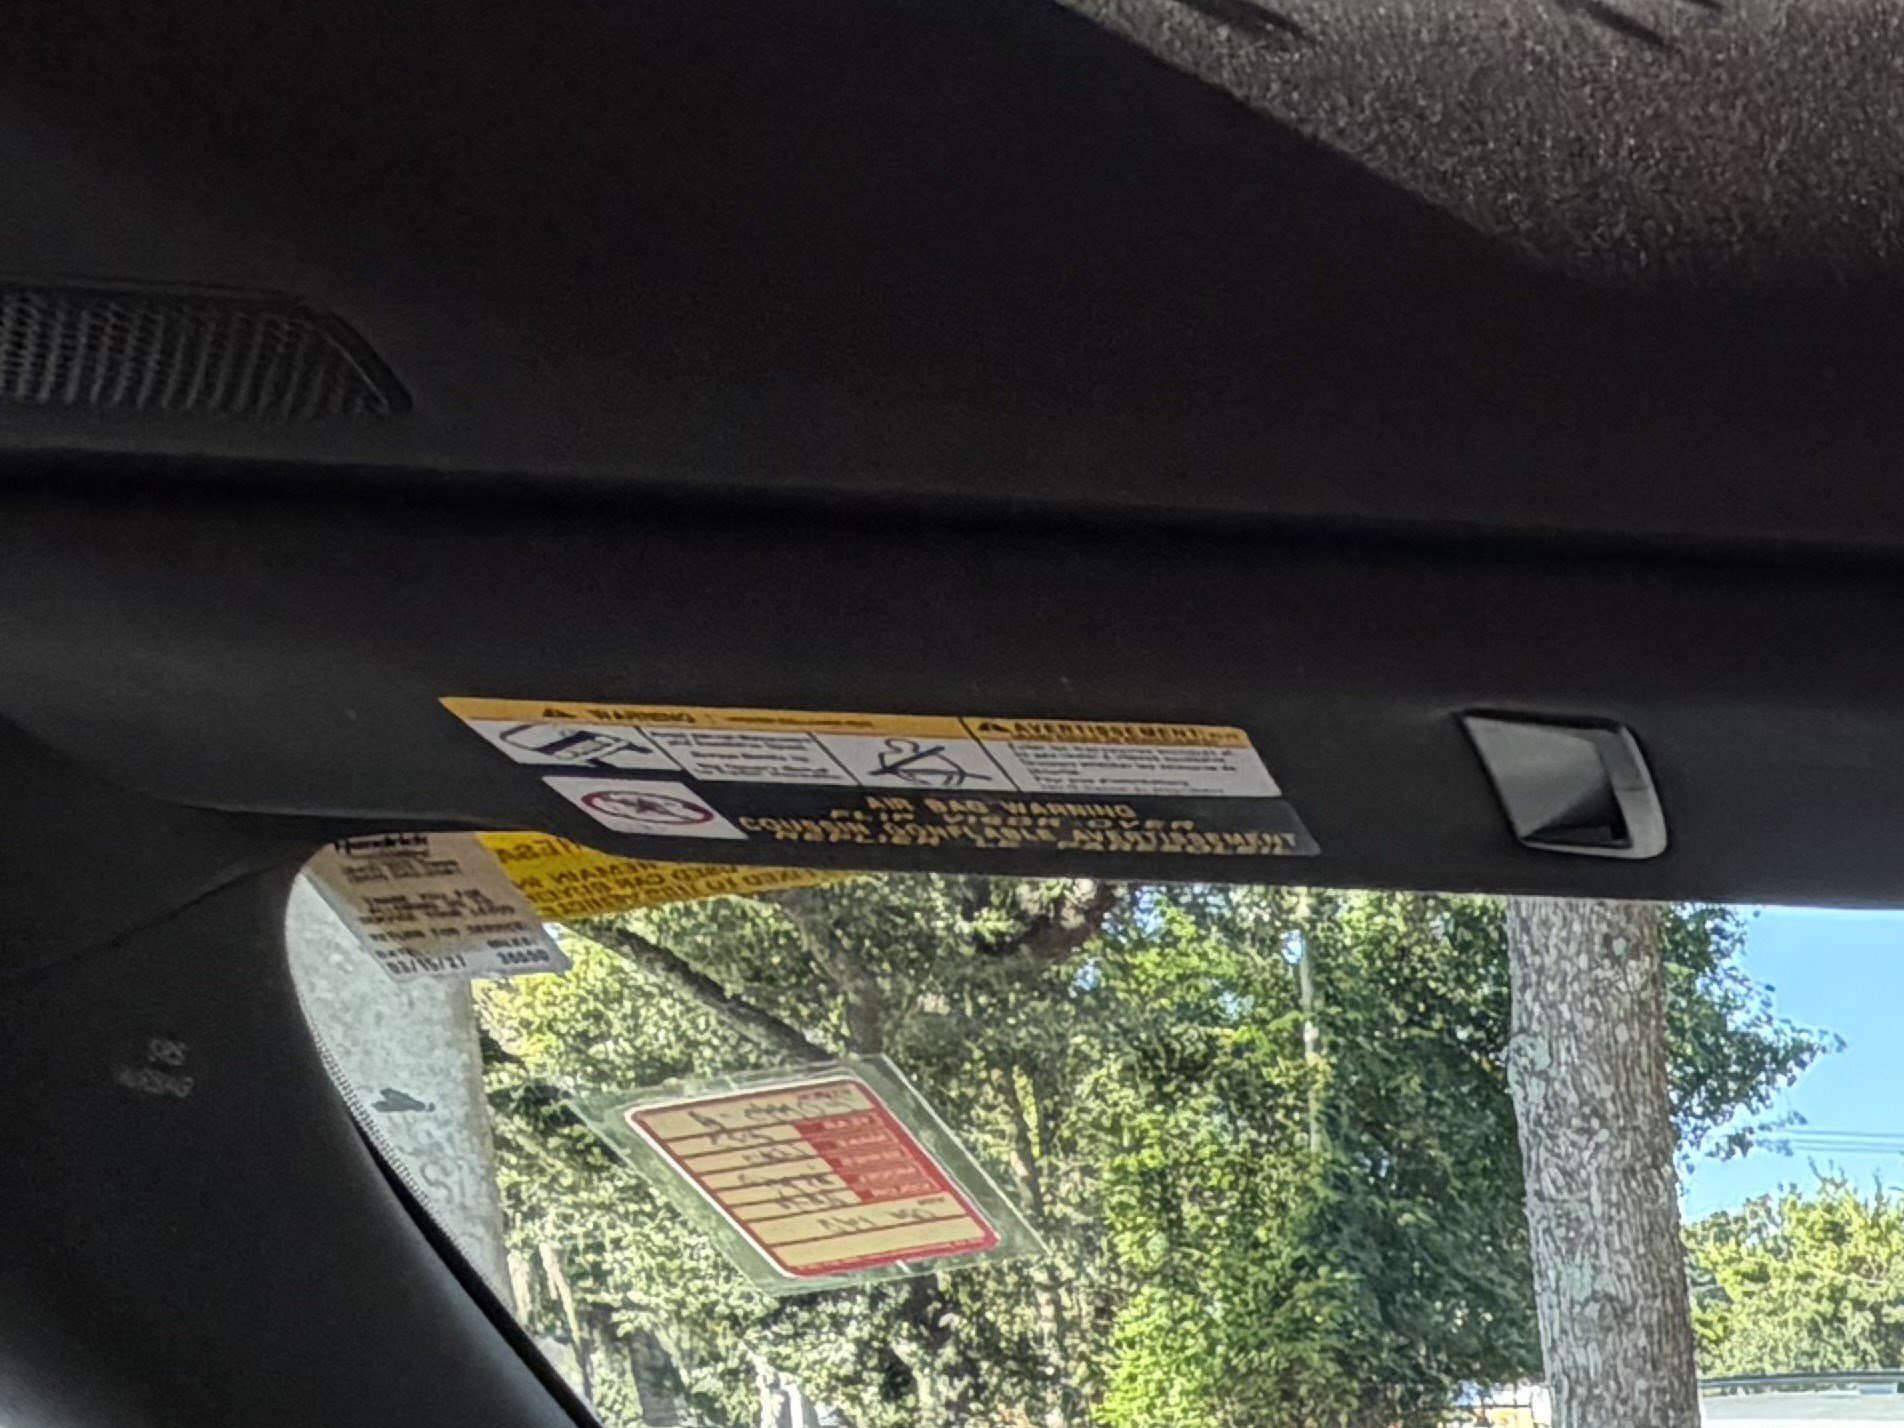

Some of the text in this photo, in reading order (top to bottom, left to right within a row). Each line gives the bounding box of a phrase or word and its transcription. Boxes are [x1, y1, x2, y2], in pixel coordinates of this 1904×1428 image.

[866, 796, 1137, 818] AIR BAG WARNING
